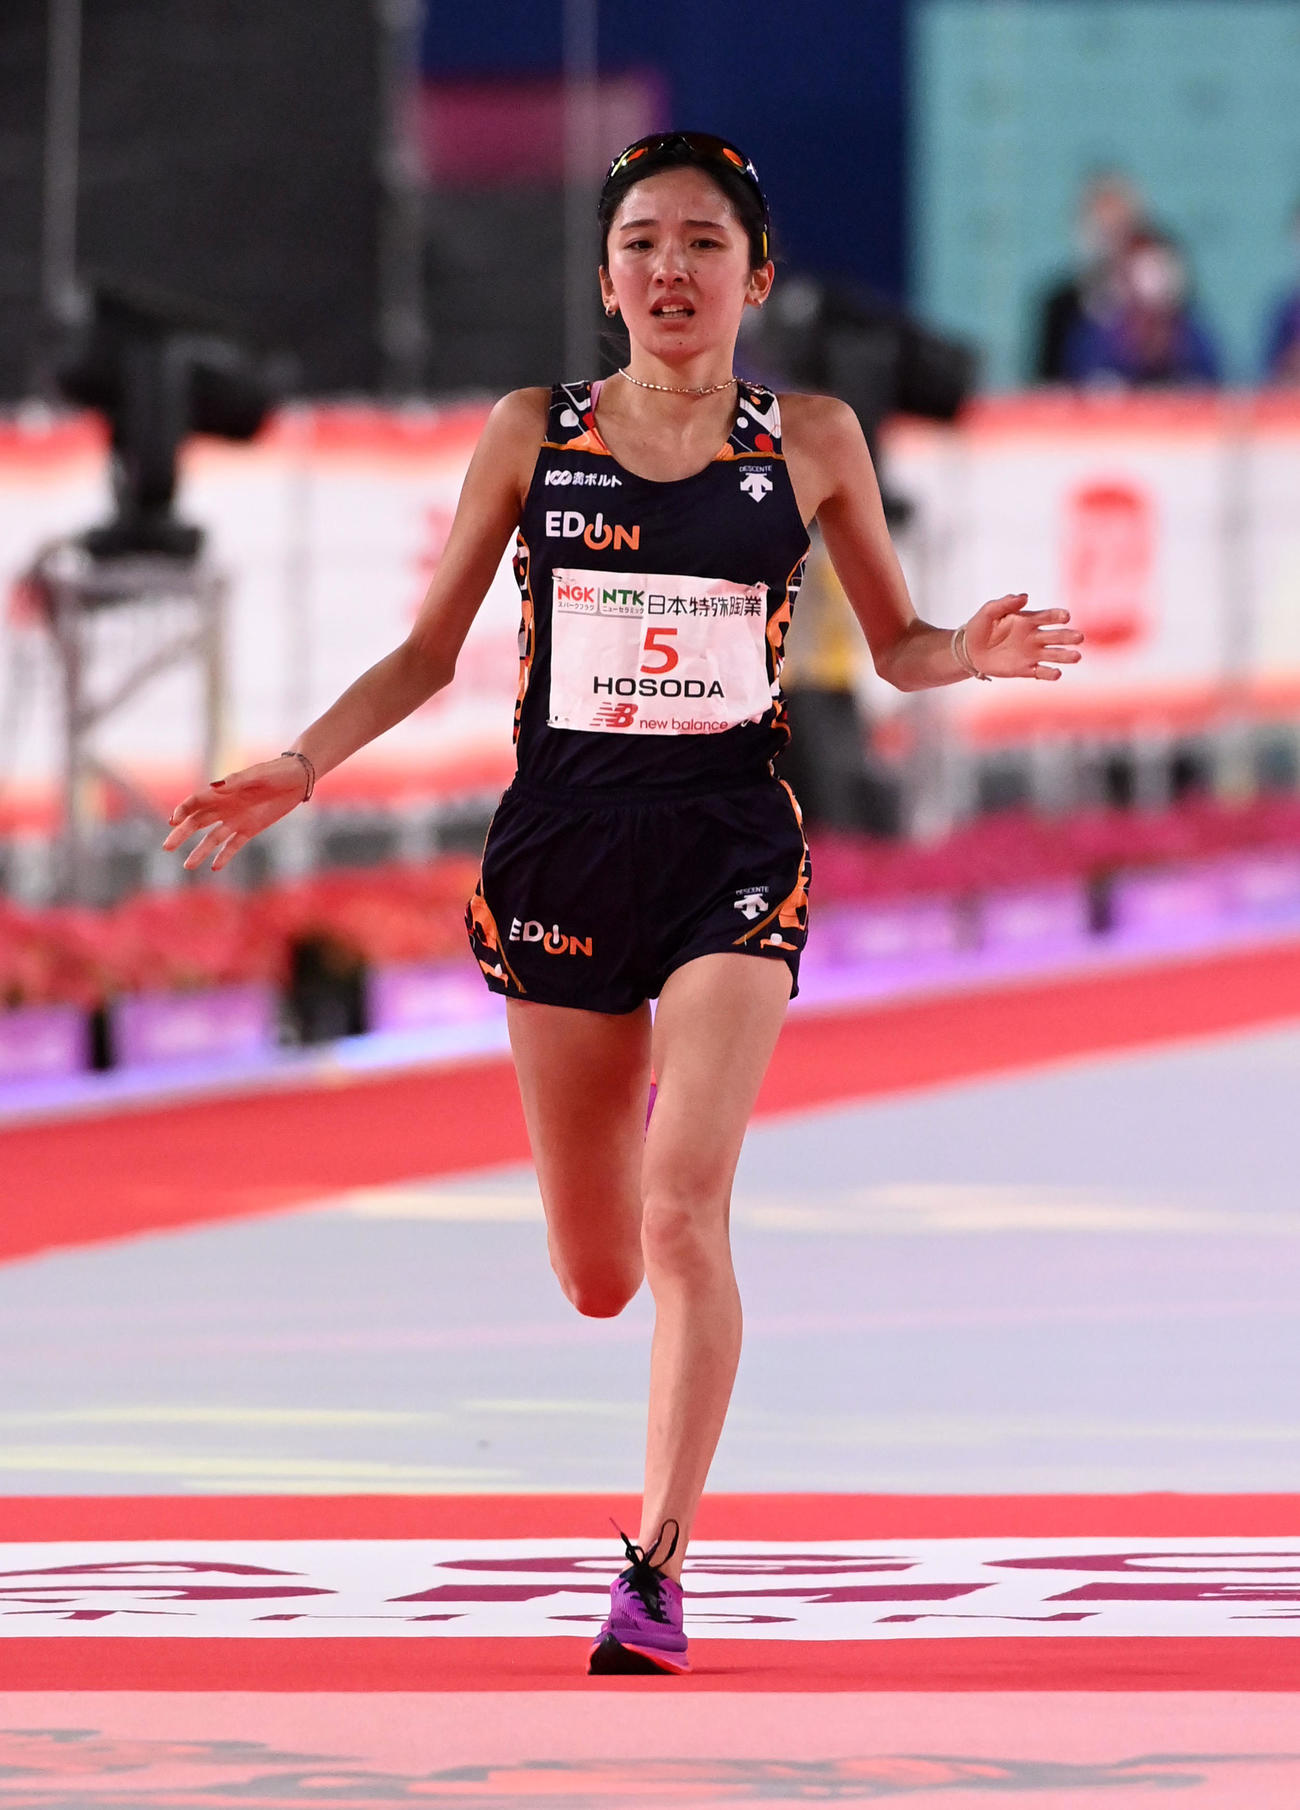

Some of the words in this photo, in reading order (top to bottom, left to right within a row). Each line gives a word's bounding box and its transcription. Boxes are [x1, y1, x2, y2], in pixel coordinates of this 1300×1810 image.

[557, 585, 595, 603] NGK
[602, 589, 645, 606] NTK
[648, 595, 762, 617] 日本特殊陶業
[640, 627, 679, 674] 5
[593, 676, 725, 698] HOSODA
[640, 718, 668, 730] new
[671, 717, 729, 731] balance
